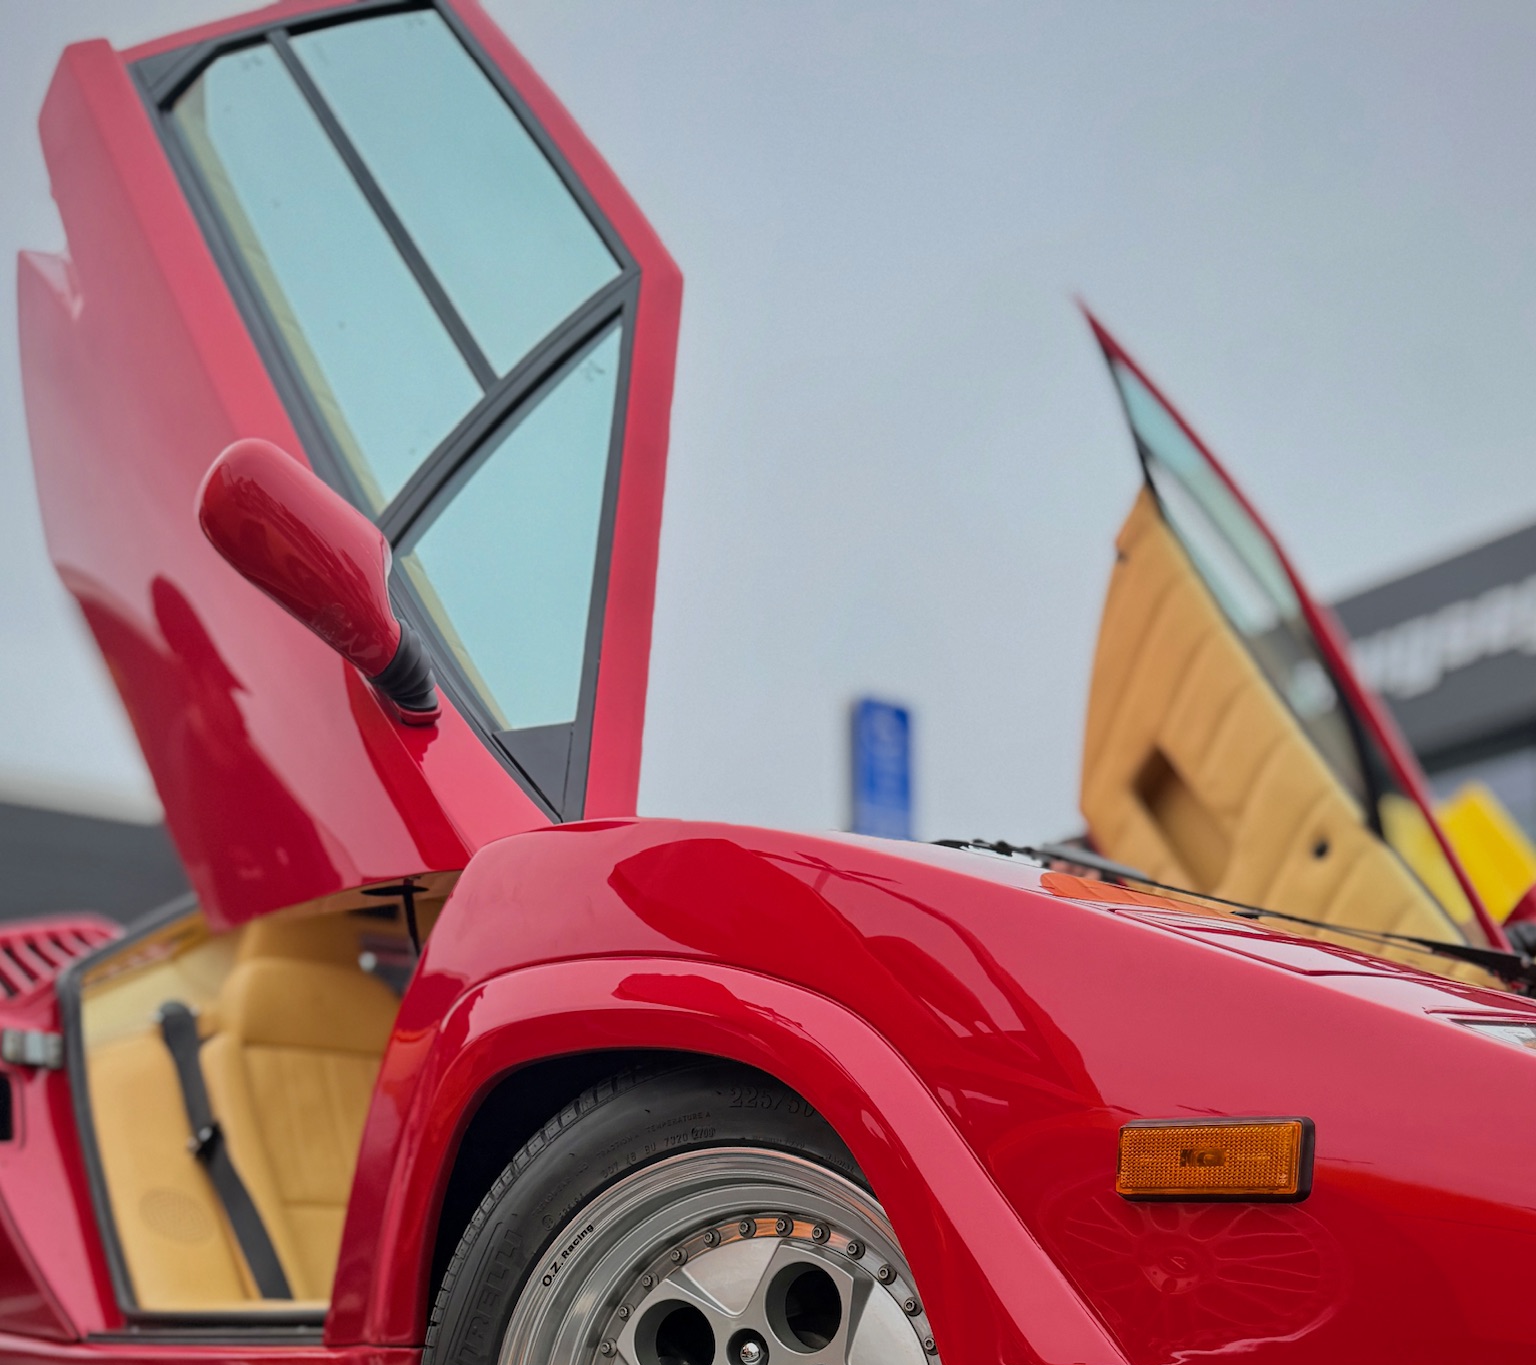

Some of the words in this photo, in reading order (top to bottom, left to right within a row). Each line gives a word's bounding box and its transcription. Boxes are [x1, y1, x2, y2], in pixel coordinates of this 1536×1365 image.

[646, 1112, 703, 1132] TEMPERATURE
[542, 1262, 564, 1287] O.Z.
[561, 1223, 594, 1259] Racing
